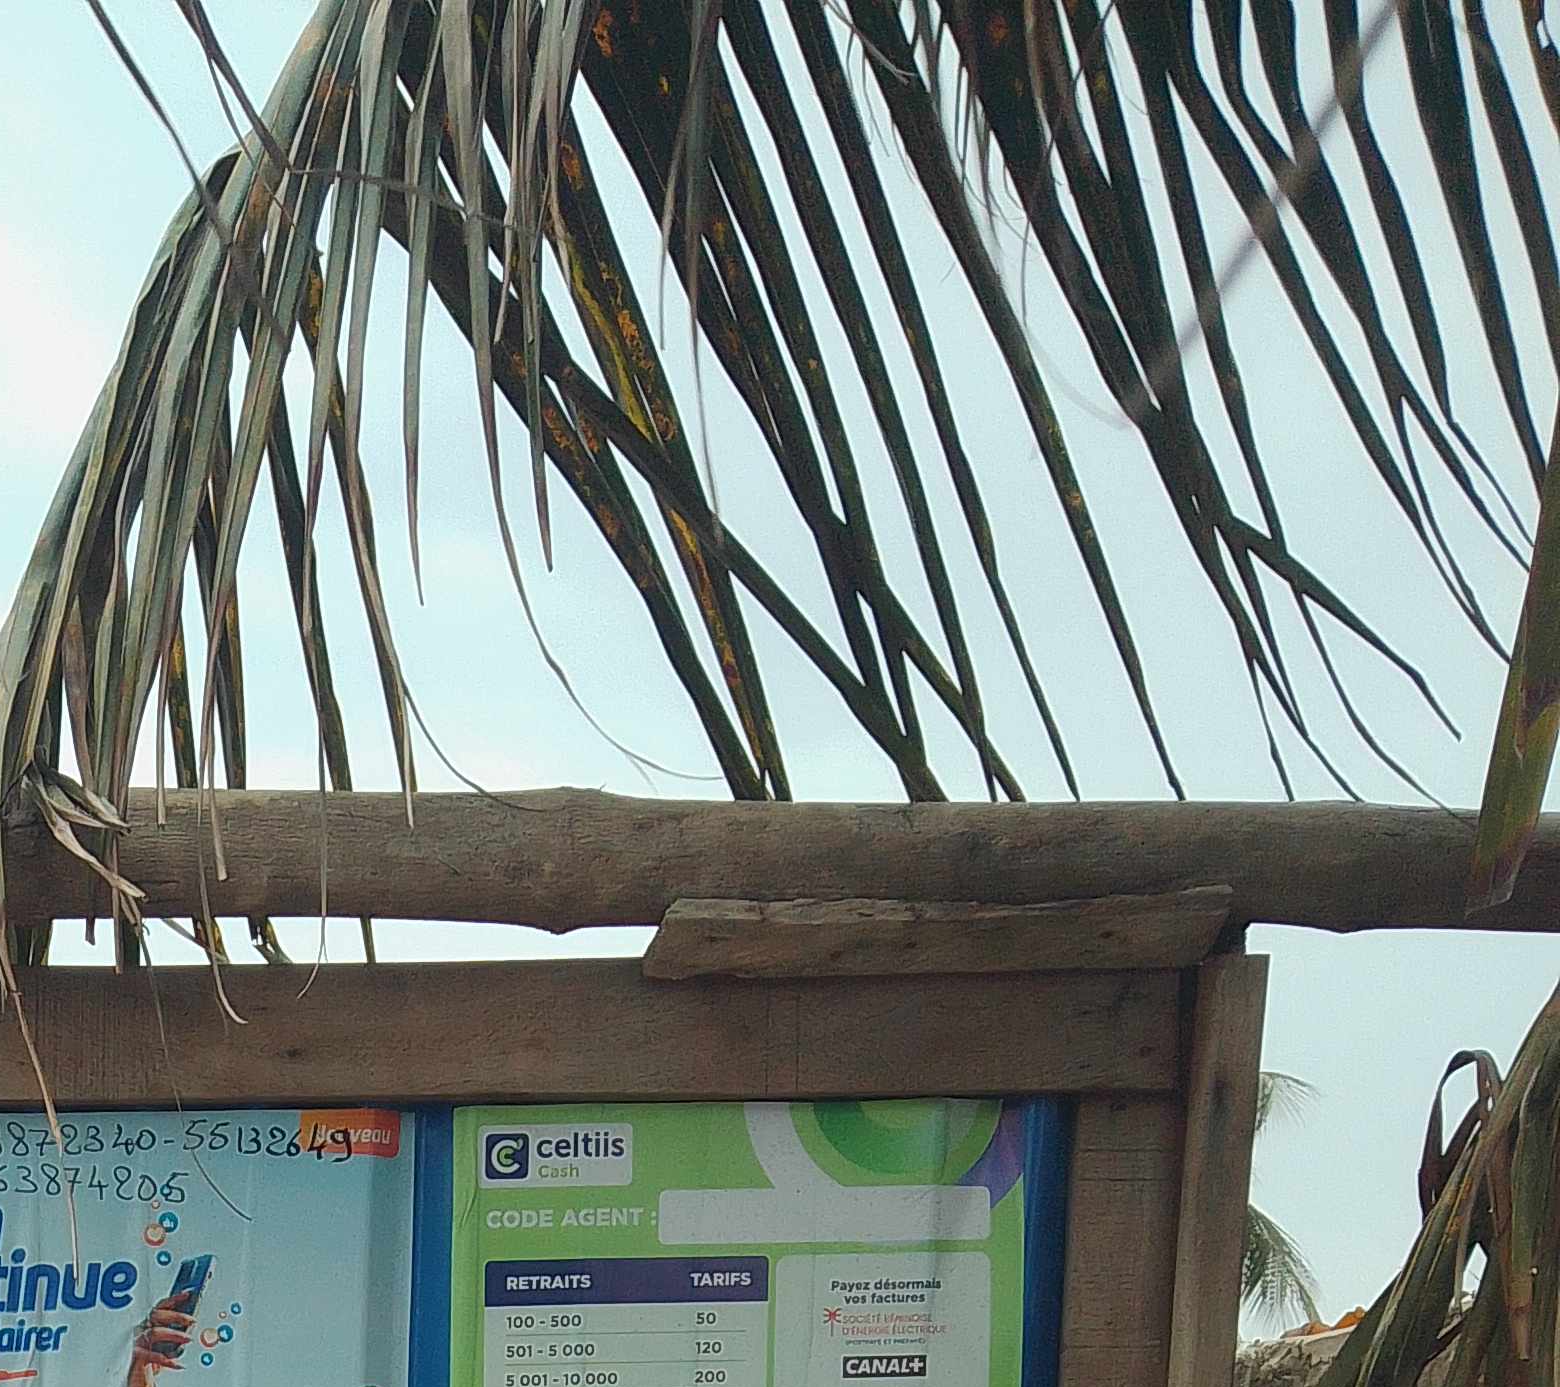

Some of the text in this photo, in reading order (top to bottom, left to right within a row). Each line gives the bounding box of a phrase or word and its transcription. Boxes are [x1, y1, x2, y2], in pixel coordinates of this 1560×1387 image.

[536, 1131, 625, 1160] celtiis
[538, 1163, 580, 1179] Cash
[485, 1206, 644, 1230] CODE AGENT
[506, 1275, 591, 1291] RETRAITS
[690, 1272, 751, 1287] TARIFS
[831, 1277, 942, 1293] Payez désormais
[844, 1292, 926, 1304] vos factures
[506, 1314, 582, 1329] 100 500
[696, 1312, 717, 1325] 50
[695, 1341, 722, 1354] 120
[845, 1358, 925, 1376] CANAL+
[694, 1370, 726, 1383] 200
